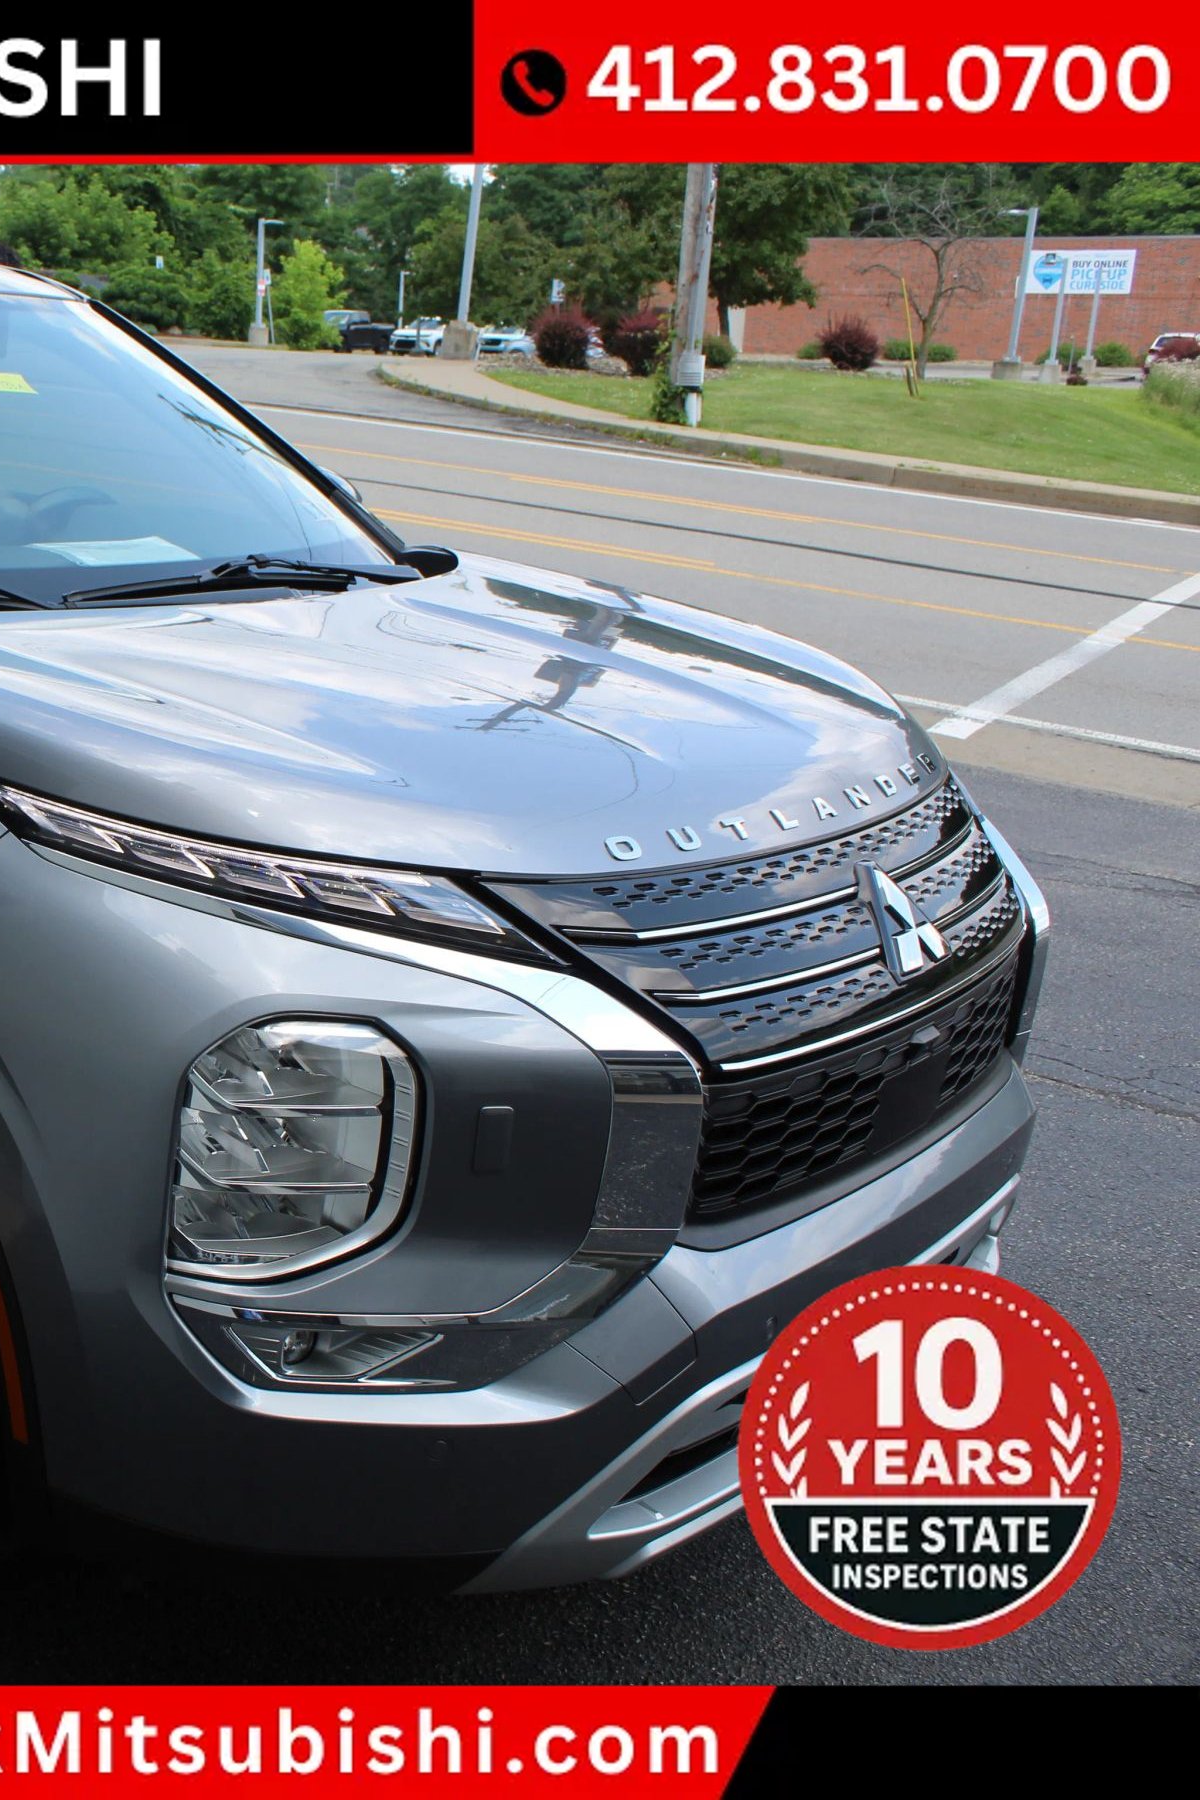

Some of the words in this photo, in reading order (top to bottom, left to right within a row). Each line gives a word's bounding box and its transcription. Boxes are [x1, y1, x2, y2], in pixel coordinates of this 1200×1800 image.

[1072, 260, 1092, 269] BUY
[1094, 260, 1129, 269] ONLINE
[604, 753, 937, 861] OUTLANDER
